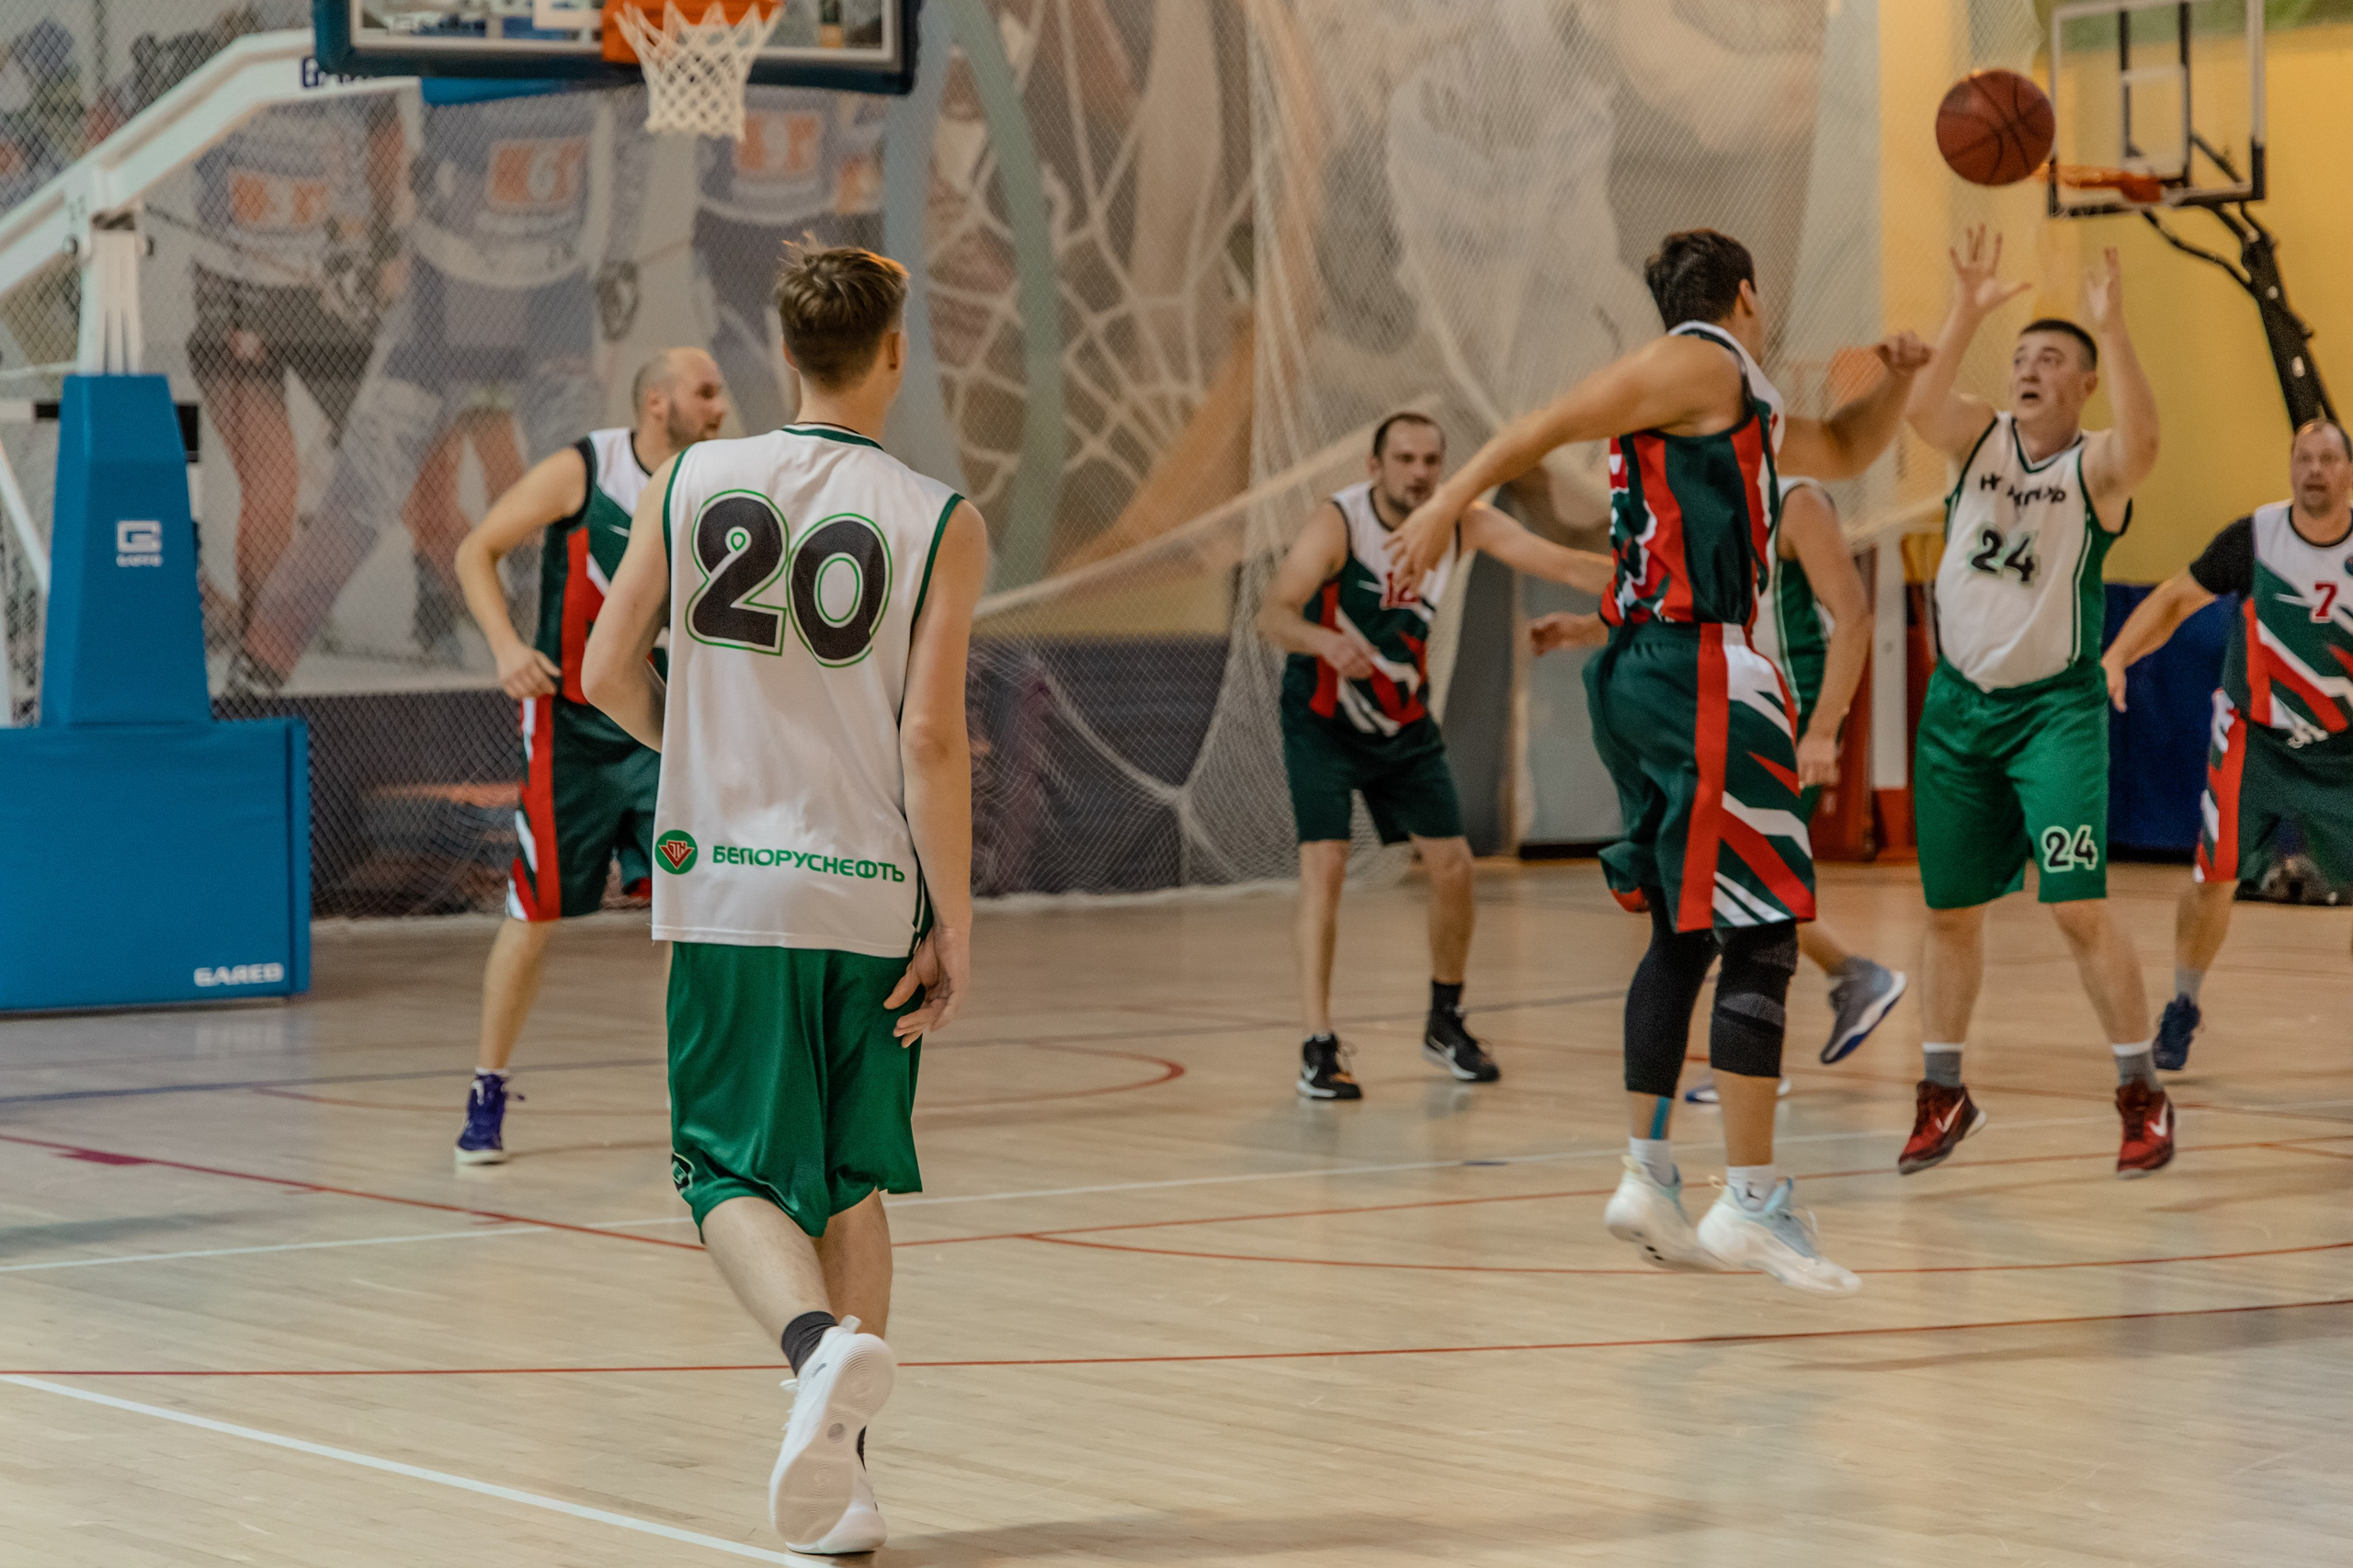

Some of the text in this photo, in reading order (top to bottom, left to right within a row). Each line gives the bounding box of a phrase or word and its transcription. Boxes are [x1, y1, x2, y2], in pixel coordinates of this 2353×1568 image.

[685, 489, 892, 668] 20
[1969, 526, 2039, 585] 24
[2312, 581, 2338, 622] 7
[712, 845, 905, 883] БЕЛОРУСНЕФТЬ
[2040, 824, 2098, 872] 24
